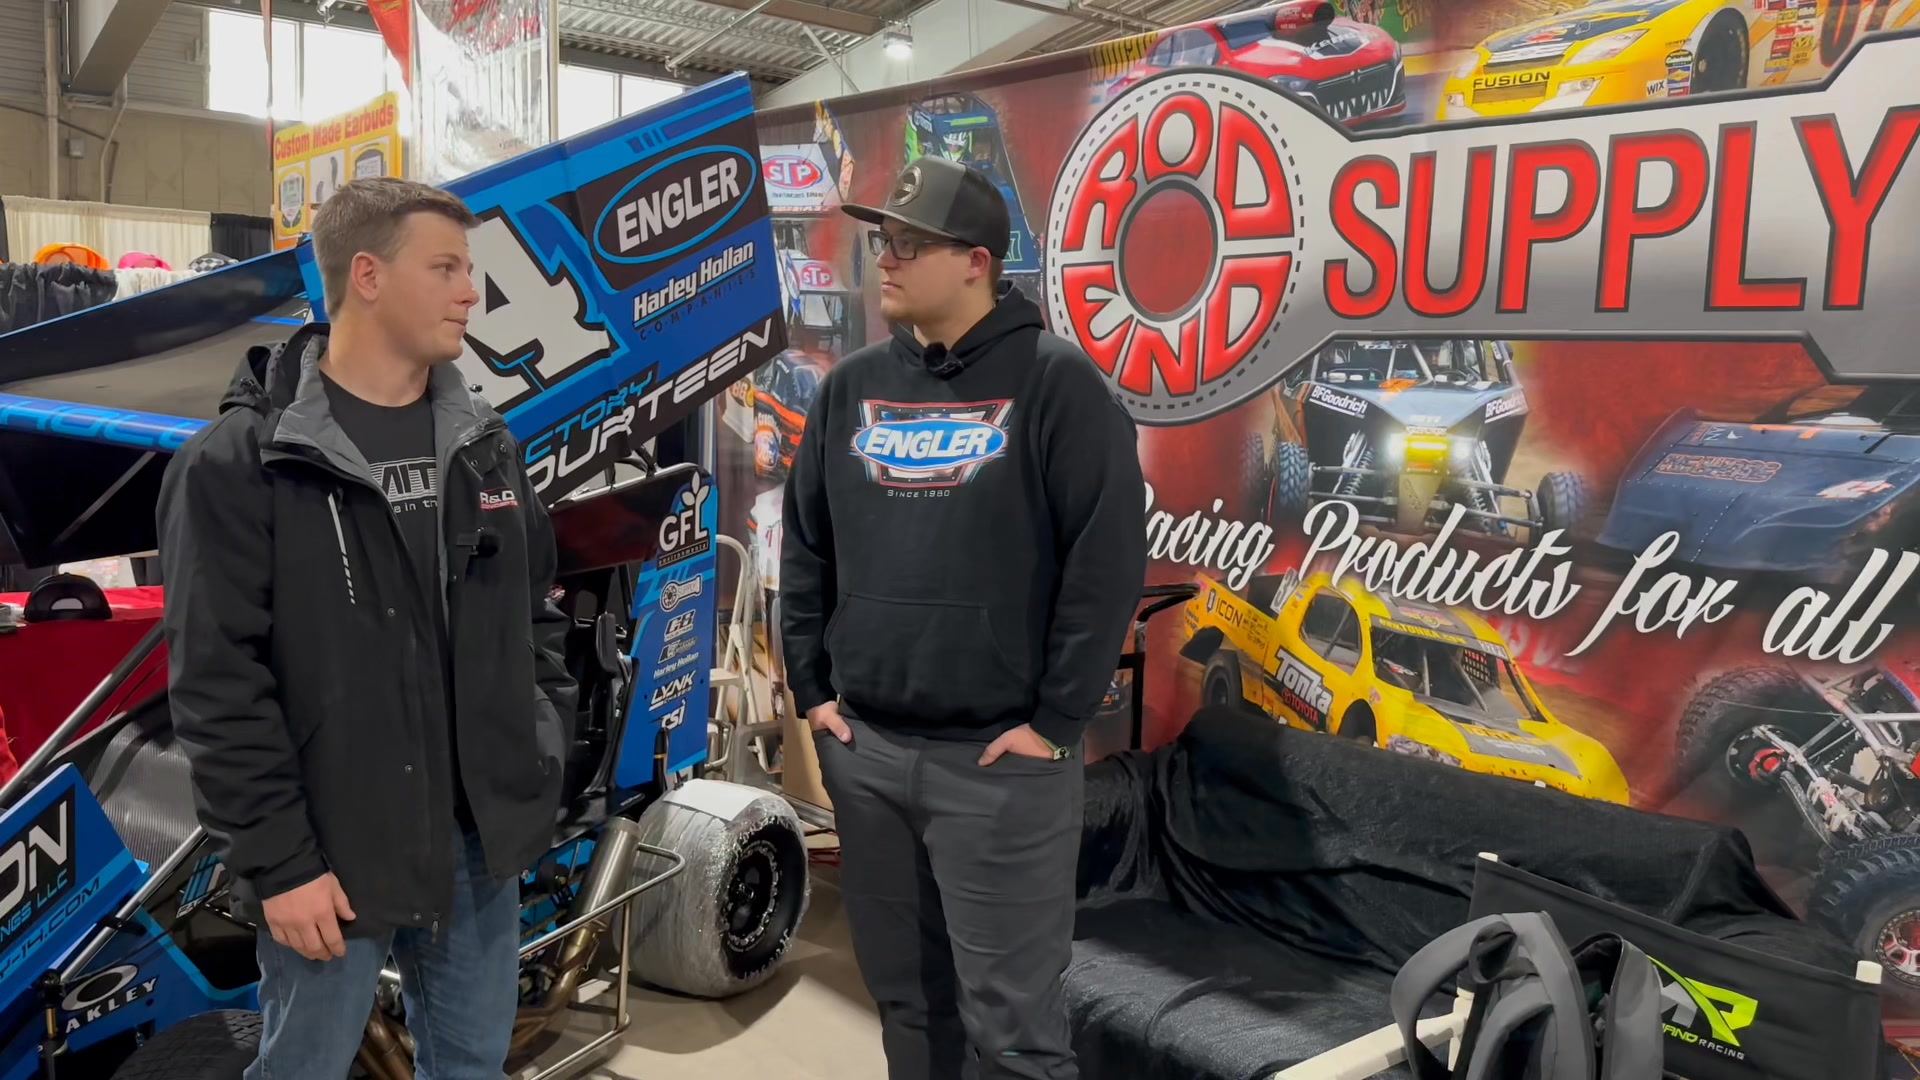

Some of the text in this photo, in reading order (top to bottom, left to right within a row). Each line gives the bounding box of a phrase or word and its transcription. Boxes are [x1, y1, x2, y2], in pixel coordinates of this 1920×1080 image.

[1473, 71, 1550, 88] FUSION
[1647, 81, 1665, 95] WIX
[275, 101, 394, 160] Custom Made Earbuds
[768, 160, 812, 185] STP
[1060, 91, 1294, 252] ROD
[617, 157, 741, 253] ENGLER
[1323, 104, 1920, 320] SUPPLY
[634, 241, 755, 323] Harley Hollan
[802, 264, 832, 288] STP
[1061, 251, 1292, 398] END
[1310, 385, 1369, 414] BFGoodrich
[864, 427, 993, 460] ENGLER
[480, 490, 516, 504] R&D
[924, 489, 951, 498] 1980
[658, 498, 709, 552] GFL
[1298, 500, 1582, 619] Products
[1563, 531, 1738, 656] for
[1762, 548, 1920, 664] all
[1216, 600, 1244, 628] ICON
[651, 670, 697, 704] LYNK
[1276, 649, 1334, 714] Tonka
[1290, 694, 1320, 724] TOYOTA
[37, 868, 69, 909] LLC
[62, 977, 158, 1036] AKLEY
[1698, 1038, 1745, 1061] RACING
